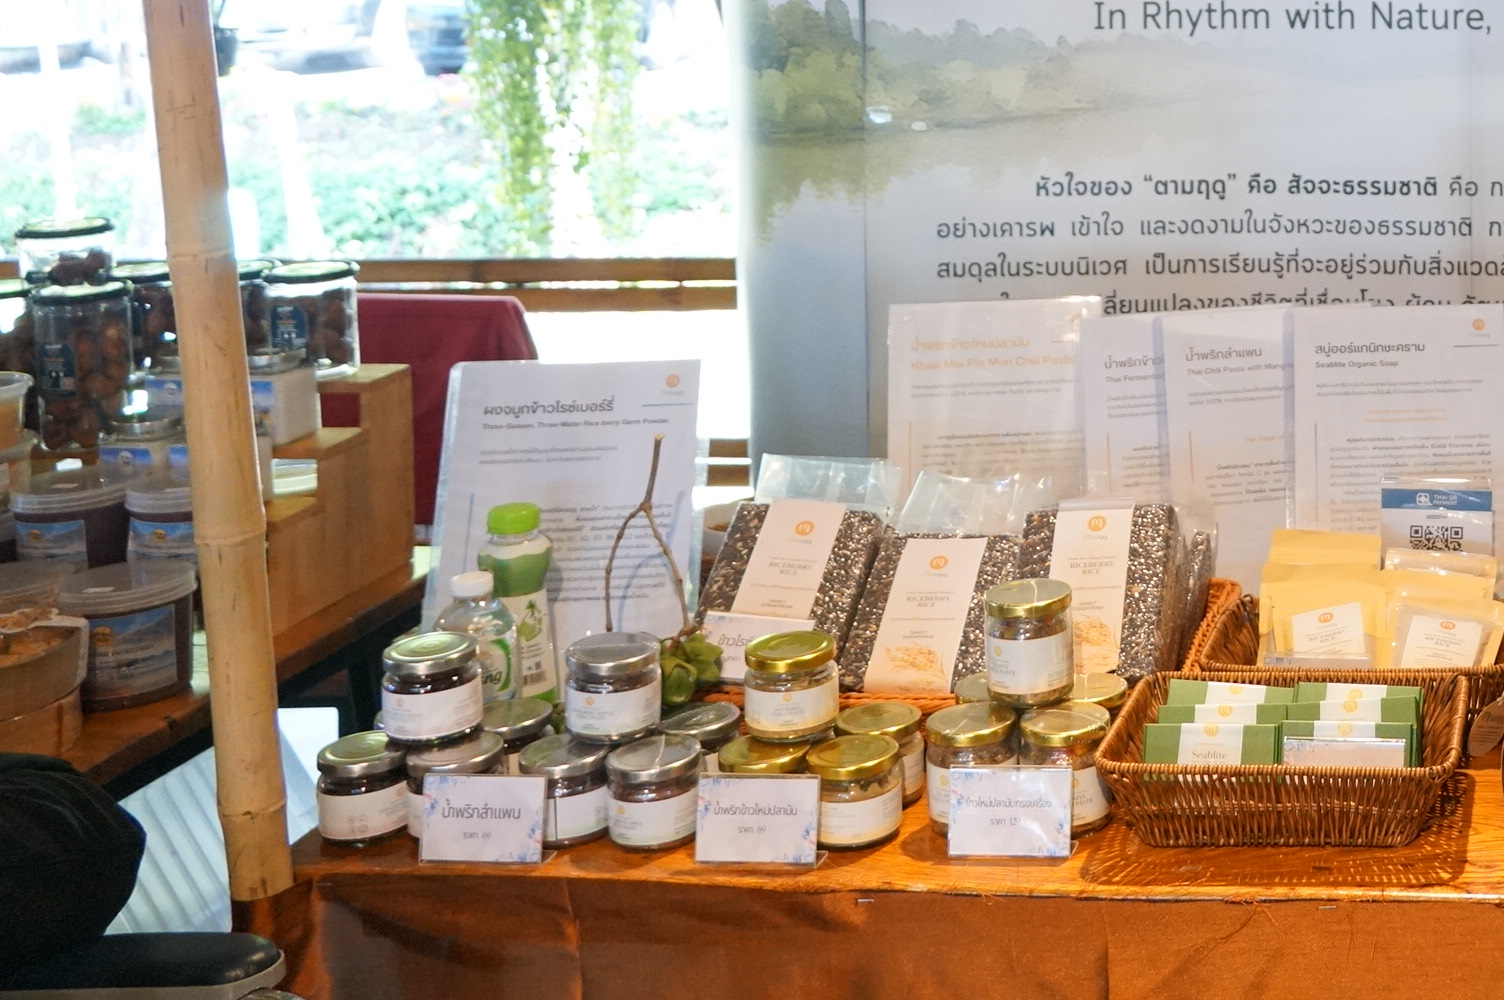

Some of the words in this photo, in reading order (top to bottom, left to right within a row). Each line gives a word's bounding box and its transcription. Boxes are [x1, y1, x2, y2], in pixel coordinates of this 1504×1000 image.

[1094, 1, 1126, 30] In
[1143, 0, 1270, 37] Rhythm
[1285, 0, 1355, 30] with
[1371, 1, 1491, 35] Nature,
[1036, 172, 1132, 196] หัวใจของ
[1144, 174, 1236, 200] “ตามฤดู”
[1248, 173, 1276, 194] คือ
[1288, 174, 1437, 196] สัจจะธรรมชาติ
[1450, 177, 1478, 196] คือ
[937, 217, 1055, 238] อย่างเคารพ
[1072, 211, 1124, 235] เข้าใจ
[1140, 209, 1472, 236] และงดงามในจังหวะของธรรมชาติ
[936, 252, 1127, 282] สมดุลในระบบนิเวศ
[1191, 750, 1227, 760] Seablite
[442, 798, 521, 819] น้ำพริกลำแพน
